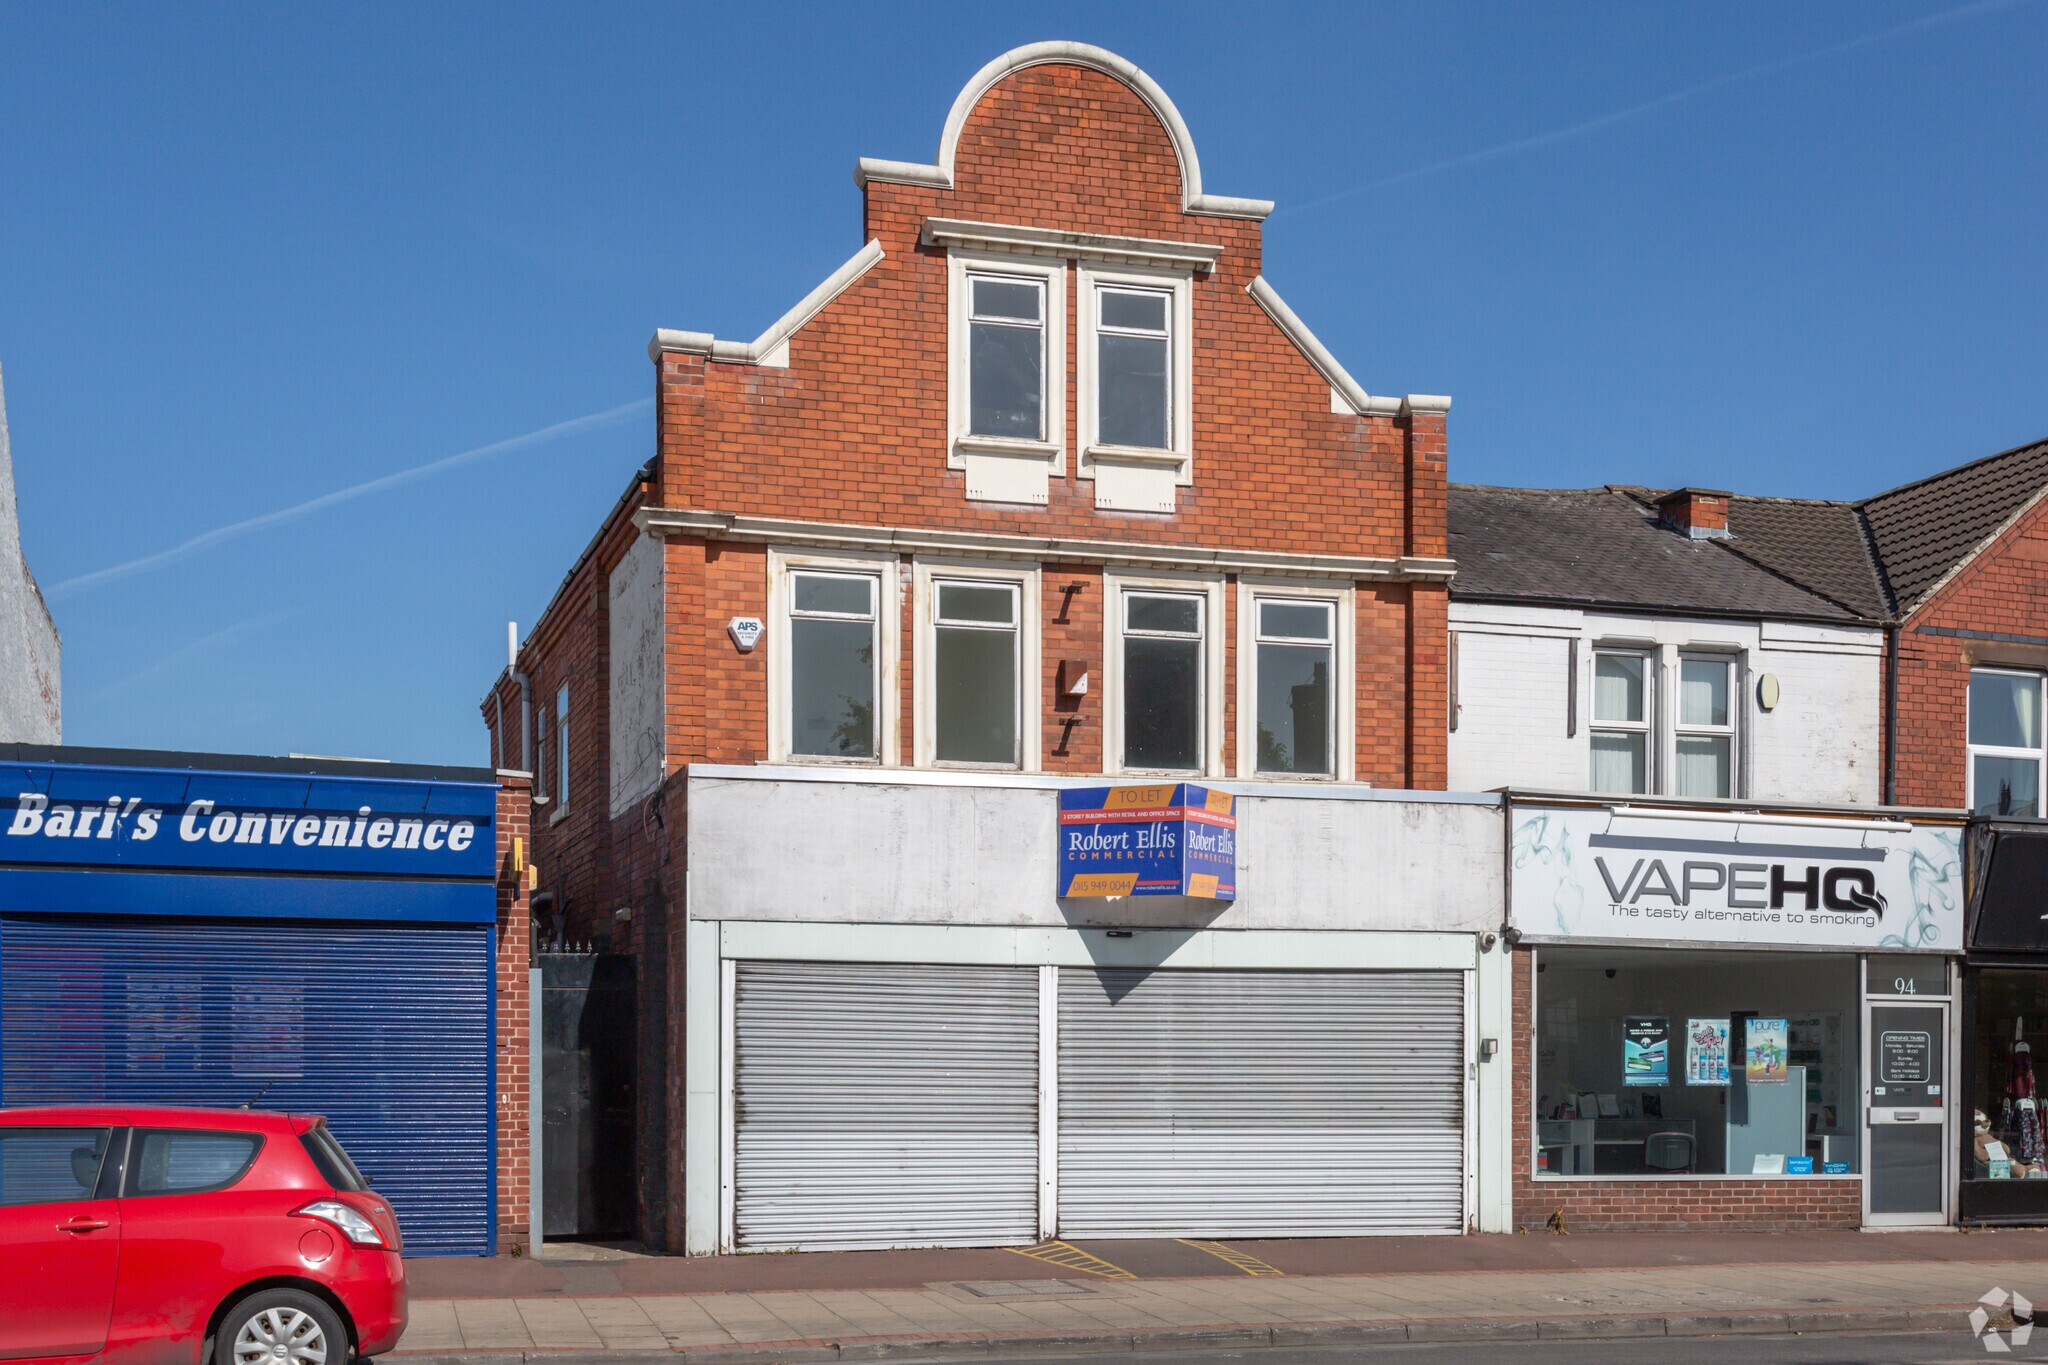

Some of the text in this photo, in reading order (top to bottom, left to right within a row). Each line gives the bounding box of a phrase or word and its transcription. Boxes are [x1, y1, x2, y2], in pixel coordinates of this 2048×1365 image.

[738, 621, 758, 631] APS
[1118, 789, 1163, 803] TO LET
[7, 792, 475, 851] Bari's Convenience
[1068, 822, 1176, 851] Robert Ellis
[1188, 823, 1234, 855] Robert Ellis
[1068, 850, 1175, 860] COMMERCIAL
[1188, 850, 1233, 865] COMMERCIAL
[1072, 880, 1131, 892] 0115 949 0044
[1608, 903, 1875, 928] The tasty alternative to smoking
[1894, 977, 1916, 995] 94
[1755, 1019, 1780, 1033] pure
